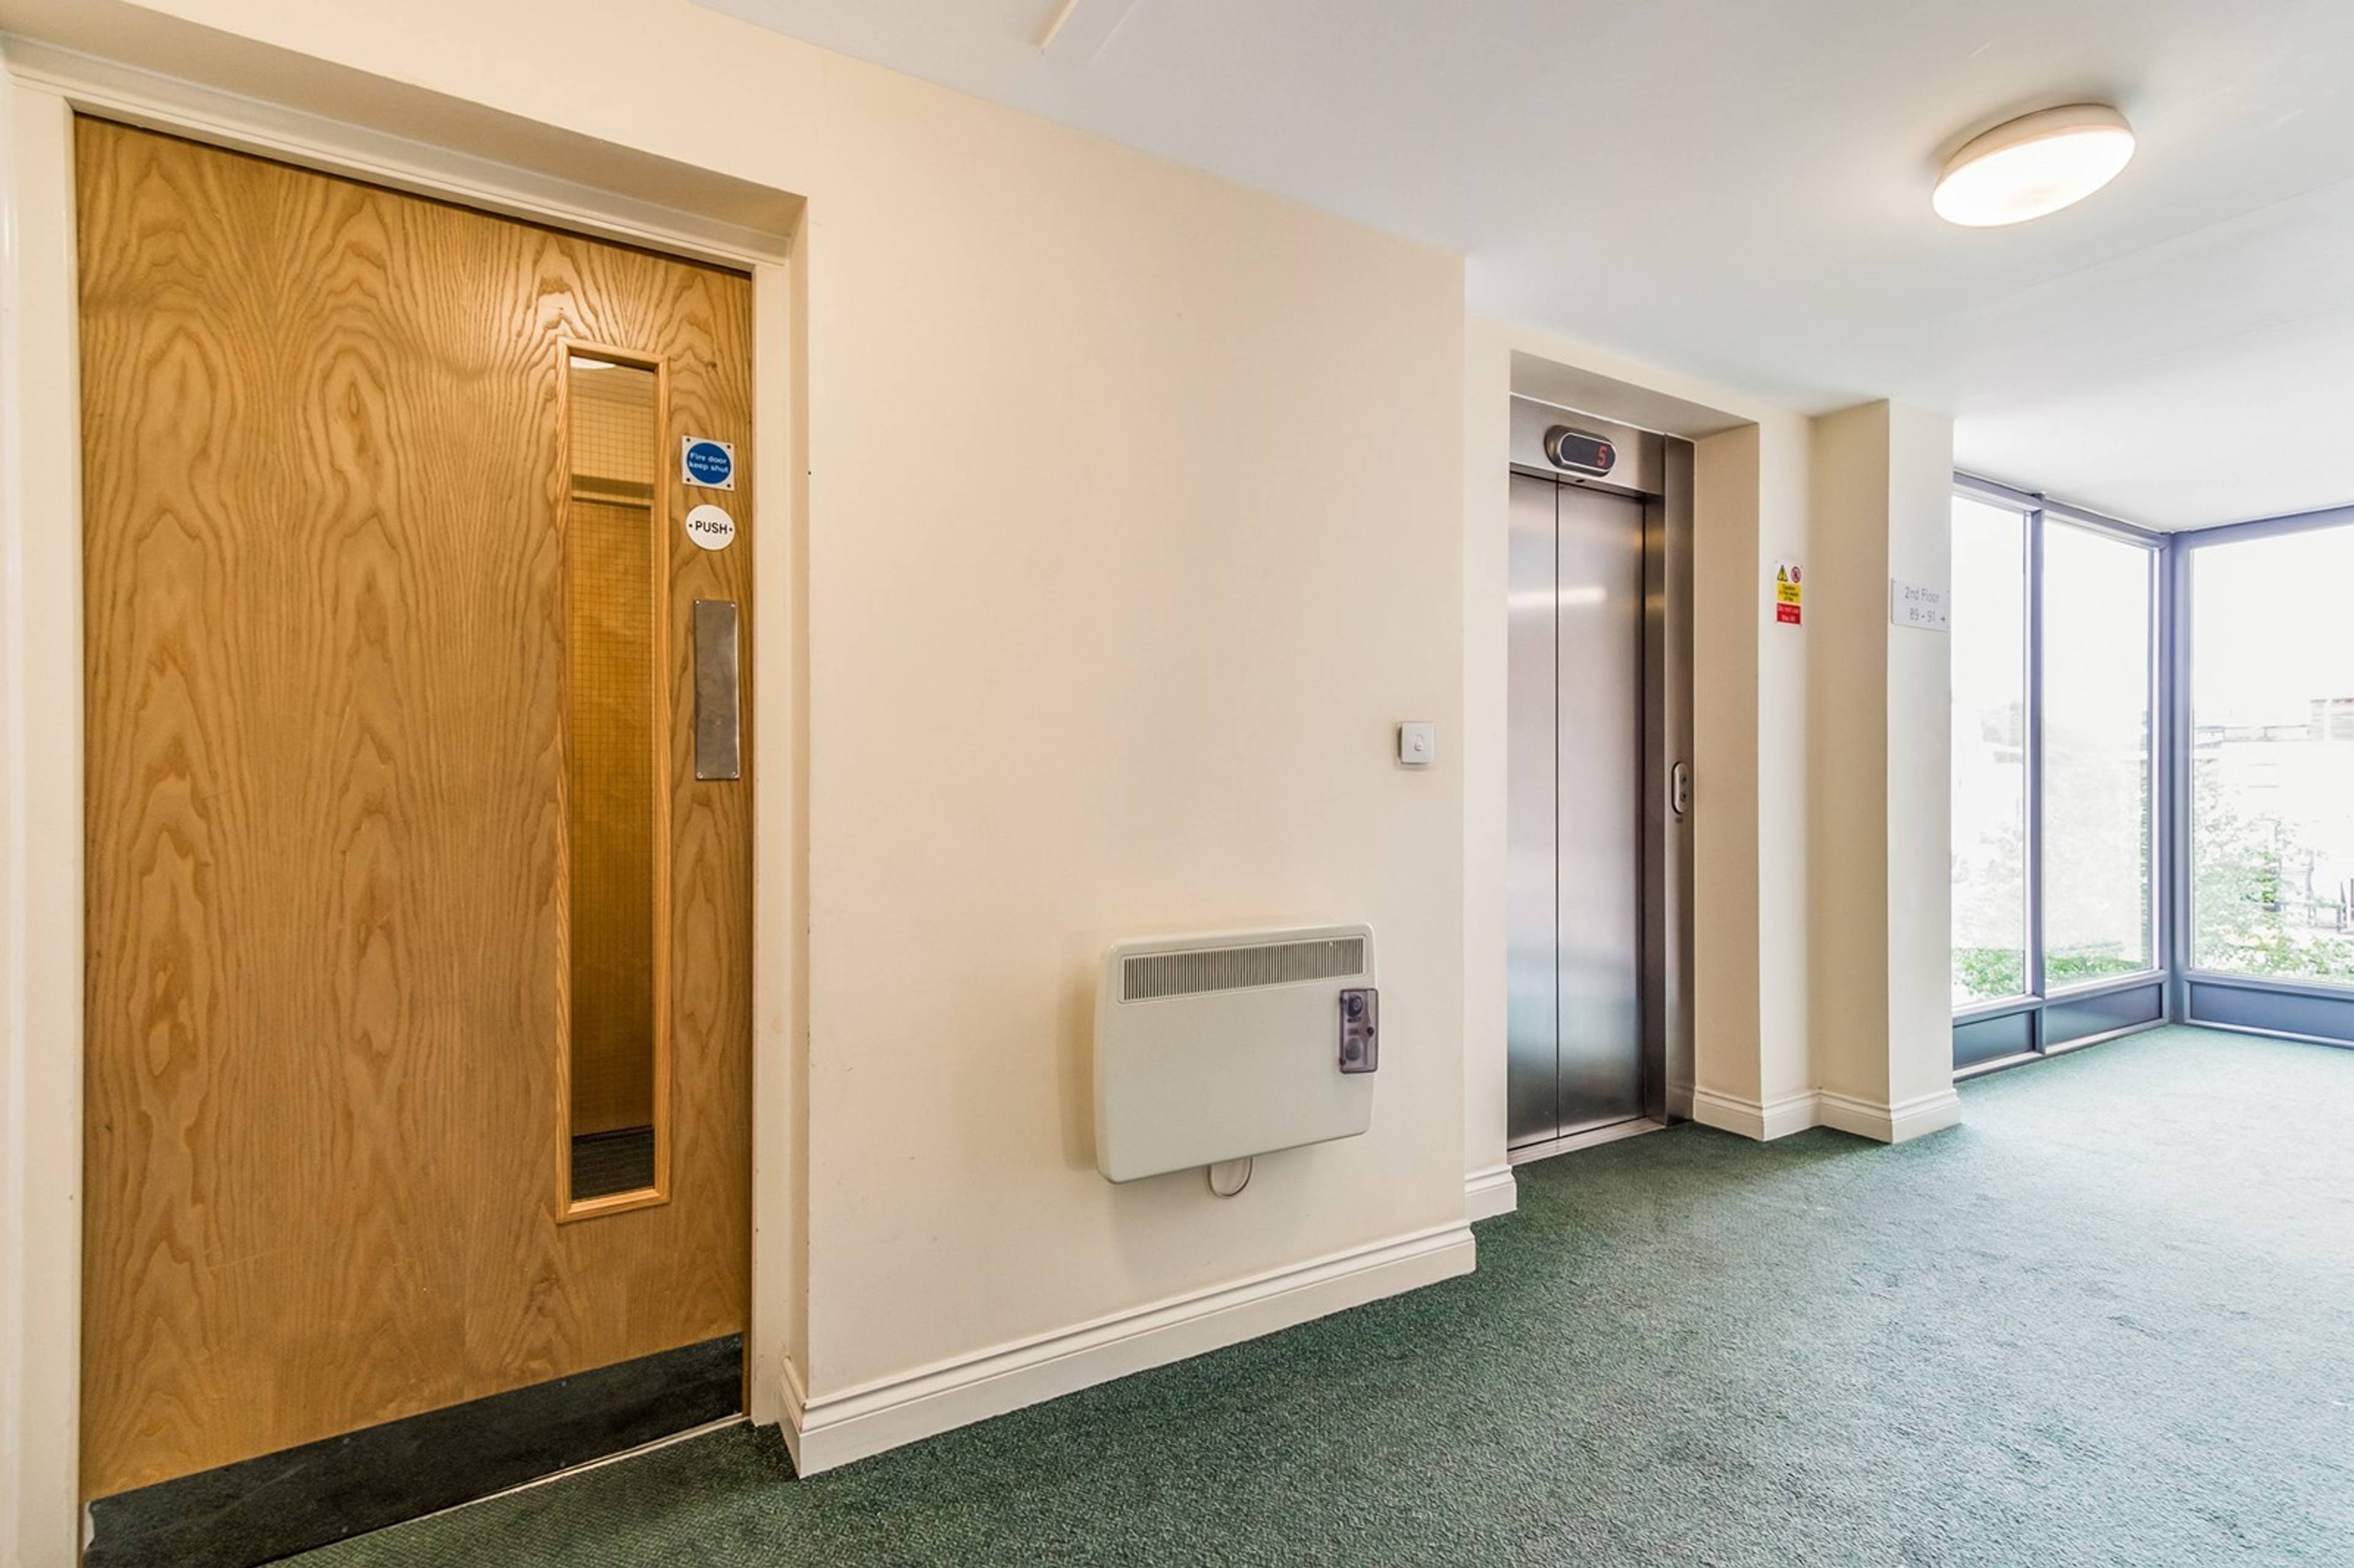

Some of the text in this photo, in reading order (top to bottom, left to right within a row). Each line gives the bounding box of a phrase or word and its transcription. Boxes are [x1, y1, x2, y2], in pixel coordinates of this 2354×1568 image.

[690, 451, 727, 465] Fire door
[1597, 445, 1607, 466] 5
[688, 460, 728, 473] keep shut
[695, 520, 728, 535] PUSH
[1905, 586, 1940, 603] 2nd Floor
